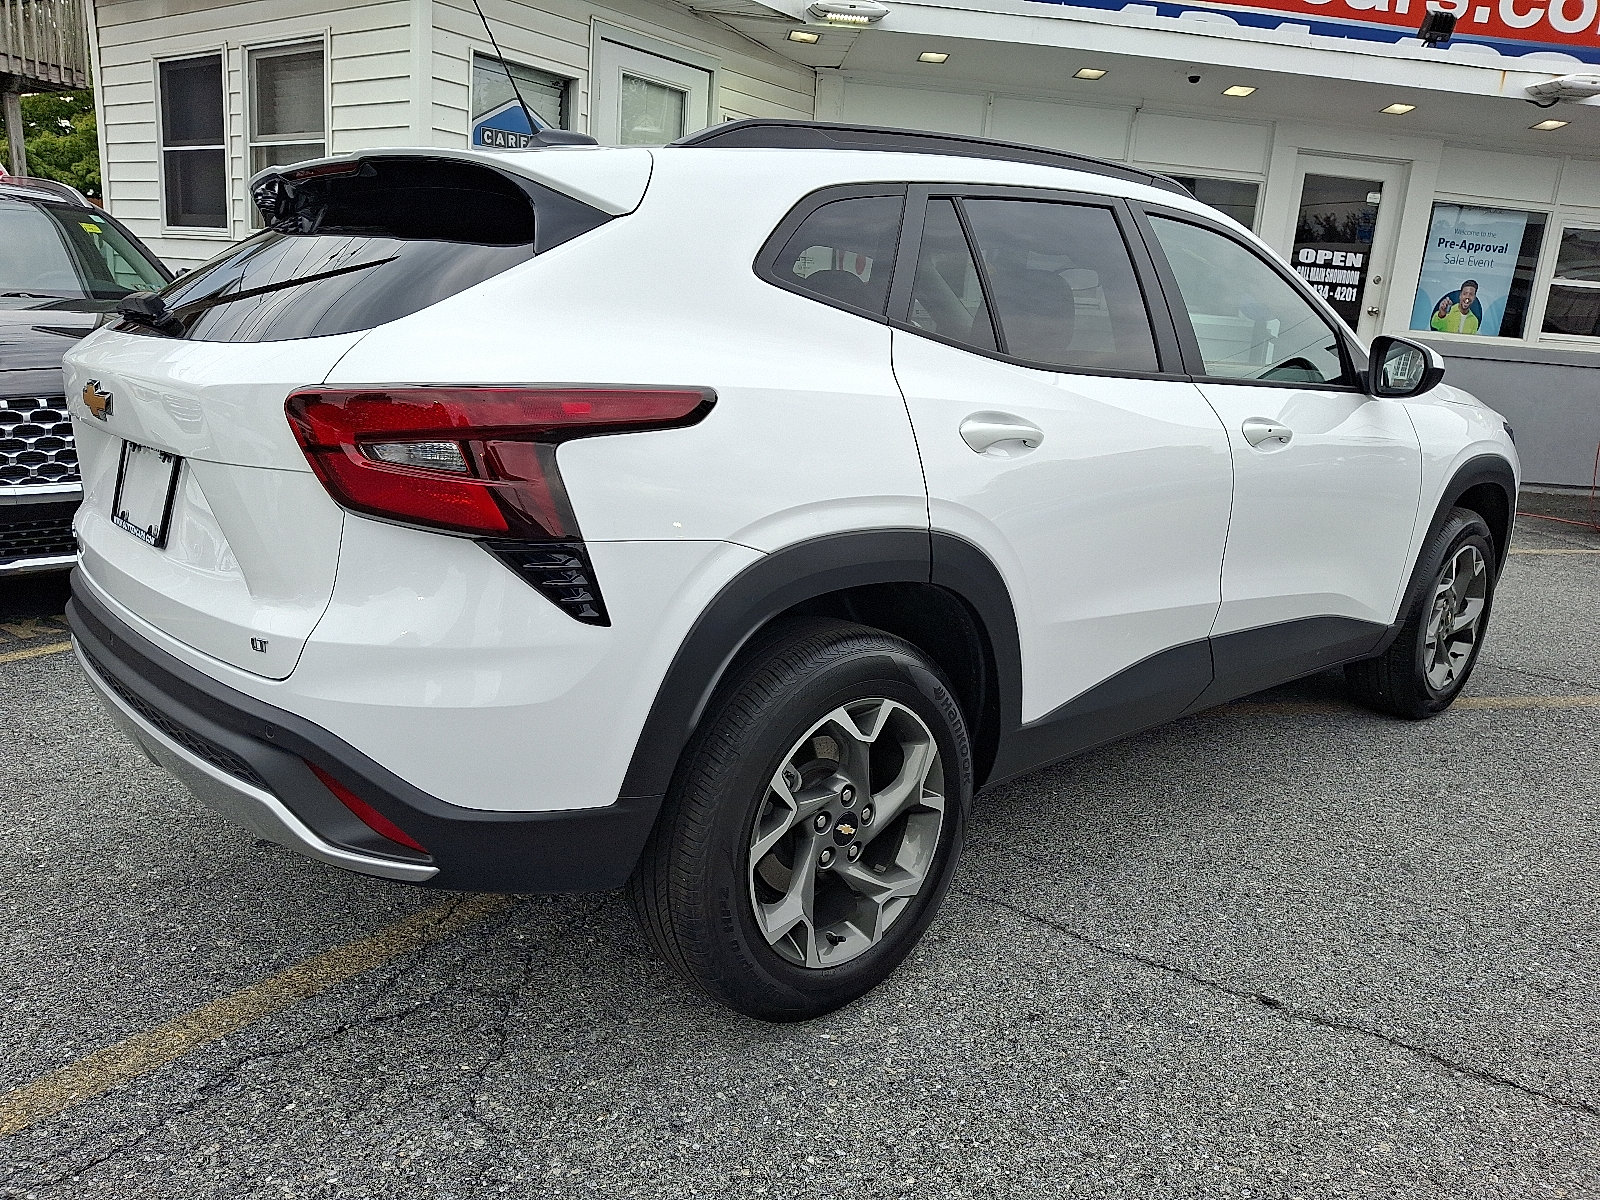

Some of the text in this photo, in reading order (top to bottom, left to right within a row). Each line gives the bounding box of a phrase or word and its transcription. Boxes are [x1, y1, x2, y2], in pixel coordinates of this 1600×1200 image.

[1454, 228, 1480, 237] Welcome
[1487, 231, 1497, 239] the
[1437, 237, 1509, 254] Pre-Approval
[1299, 248, 1363, 268] OPEN
[1443, 253, 1494, 268] Sale Event
[1296, 266, 1360, 286] CALL MAIN SHOWROOM
